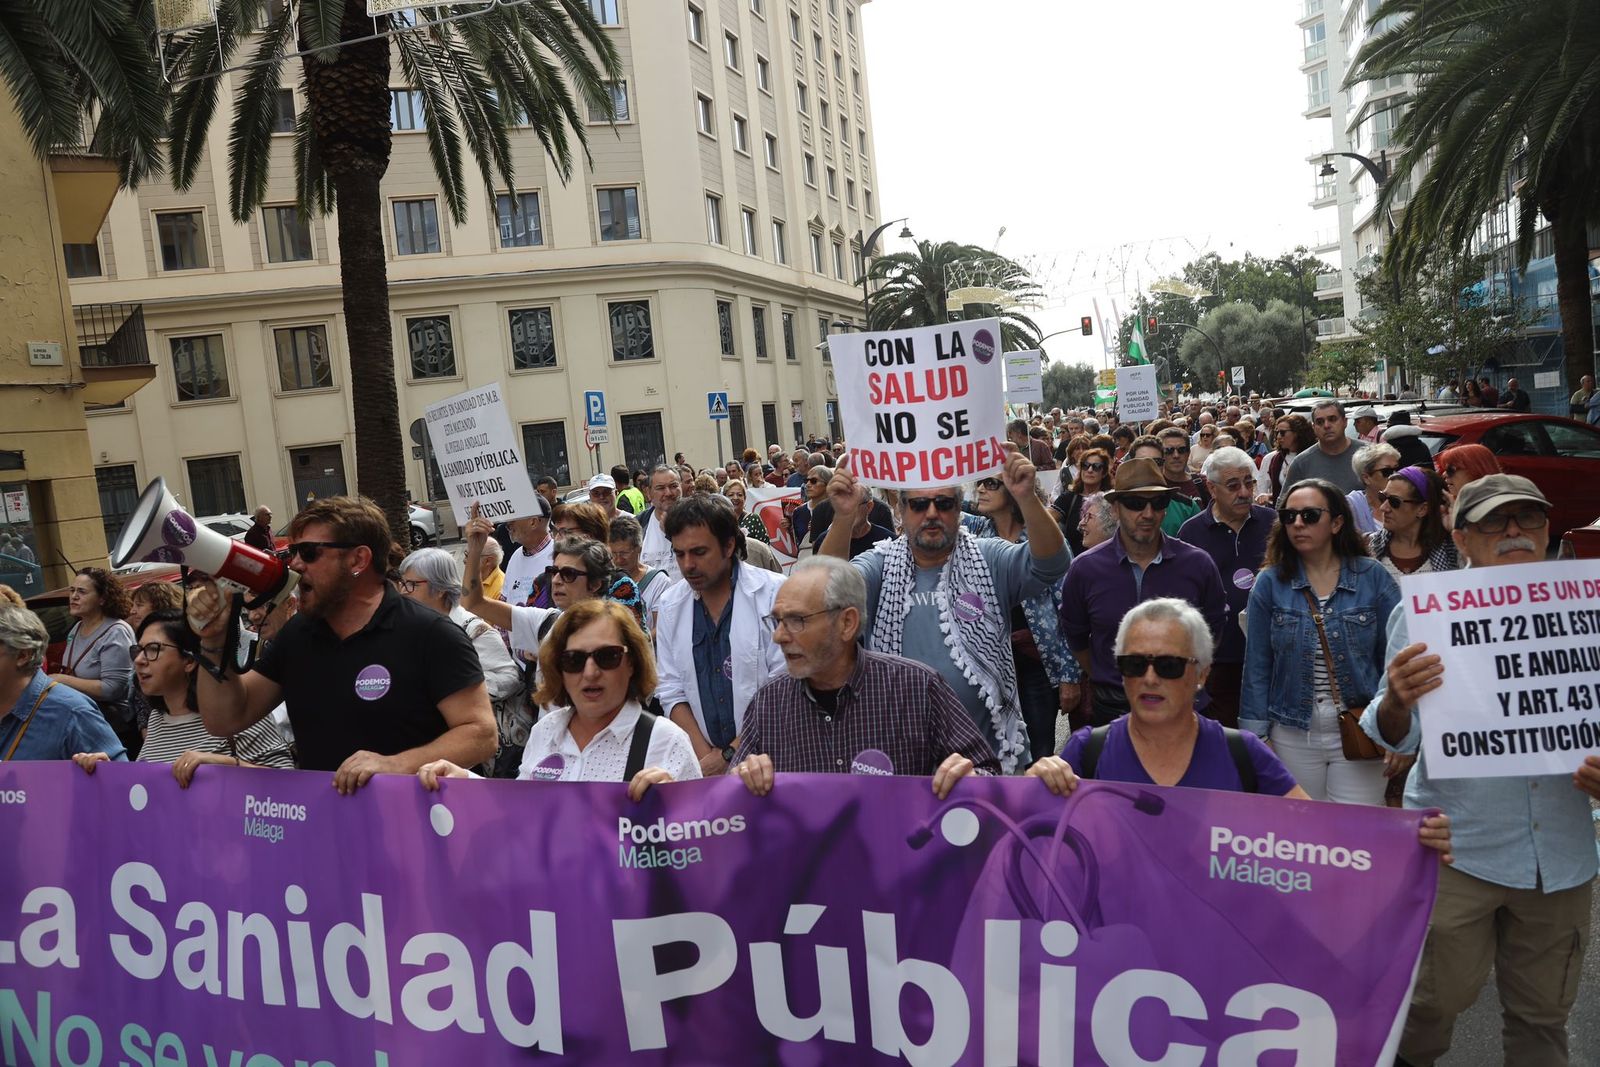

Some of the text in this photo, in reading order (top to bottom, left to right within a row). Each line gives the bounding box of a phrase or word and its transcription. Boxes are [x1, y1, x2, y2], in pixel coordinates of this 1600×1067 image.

[864, 331, 966, 367] CON LA
[476, 393, 487, 407] DE
[868, 364, 969, 405] SALUD
[589, 395, 601, 421] P
[875, 409, 971, 444] NO SE
[447, 458, 475, 476] SANIDAD
[474, 448, 519, 472] PÚBLICA
[850, 436, 1007, 482] TRAPICHEA
[472, 477, 506, 496] VENDE
[1412, 593, 1442, 614] LA
[1447, 584, 1522, 611] SALUD
[1527, 582, 1551, 603] ES
[1554, 580, 1581, 600] UN
[1451, 618, 1497, 647] ART.
[1500, 615, 1529, 642] 22
[1532, 612, 1568, 639] DEL
[355, 678, 391, 687] PODEMOS
[1495, 653, 1524, 680] DE
[1497, 692, 1511, 717] Y
[1518, 687, 1564, 716] ART.
[1567, 684, 1593, 713] 43
[245, 795, 306, 821] Podemos
[244, 816, 284, 843] Málaga
[618, 814, 746, 846] Podemos
[618, 844, 702, 870] Málaga
[1209, 825, 1373, 872] Podemos
[1208, 855, 1313, 894] Málaga
[109, 861, 564, 1056] Sanidad
[611, 903, 1338, 1067] Pública
